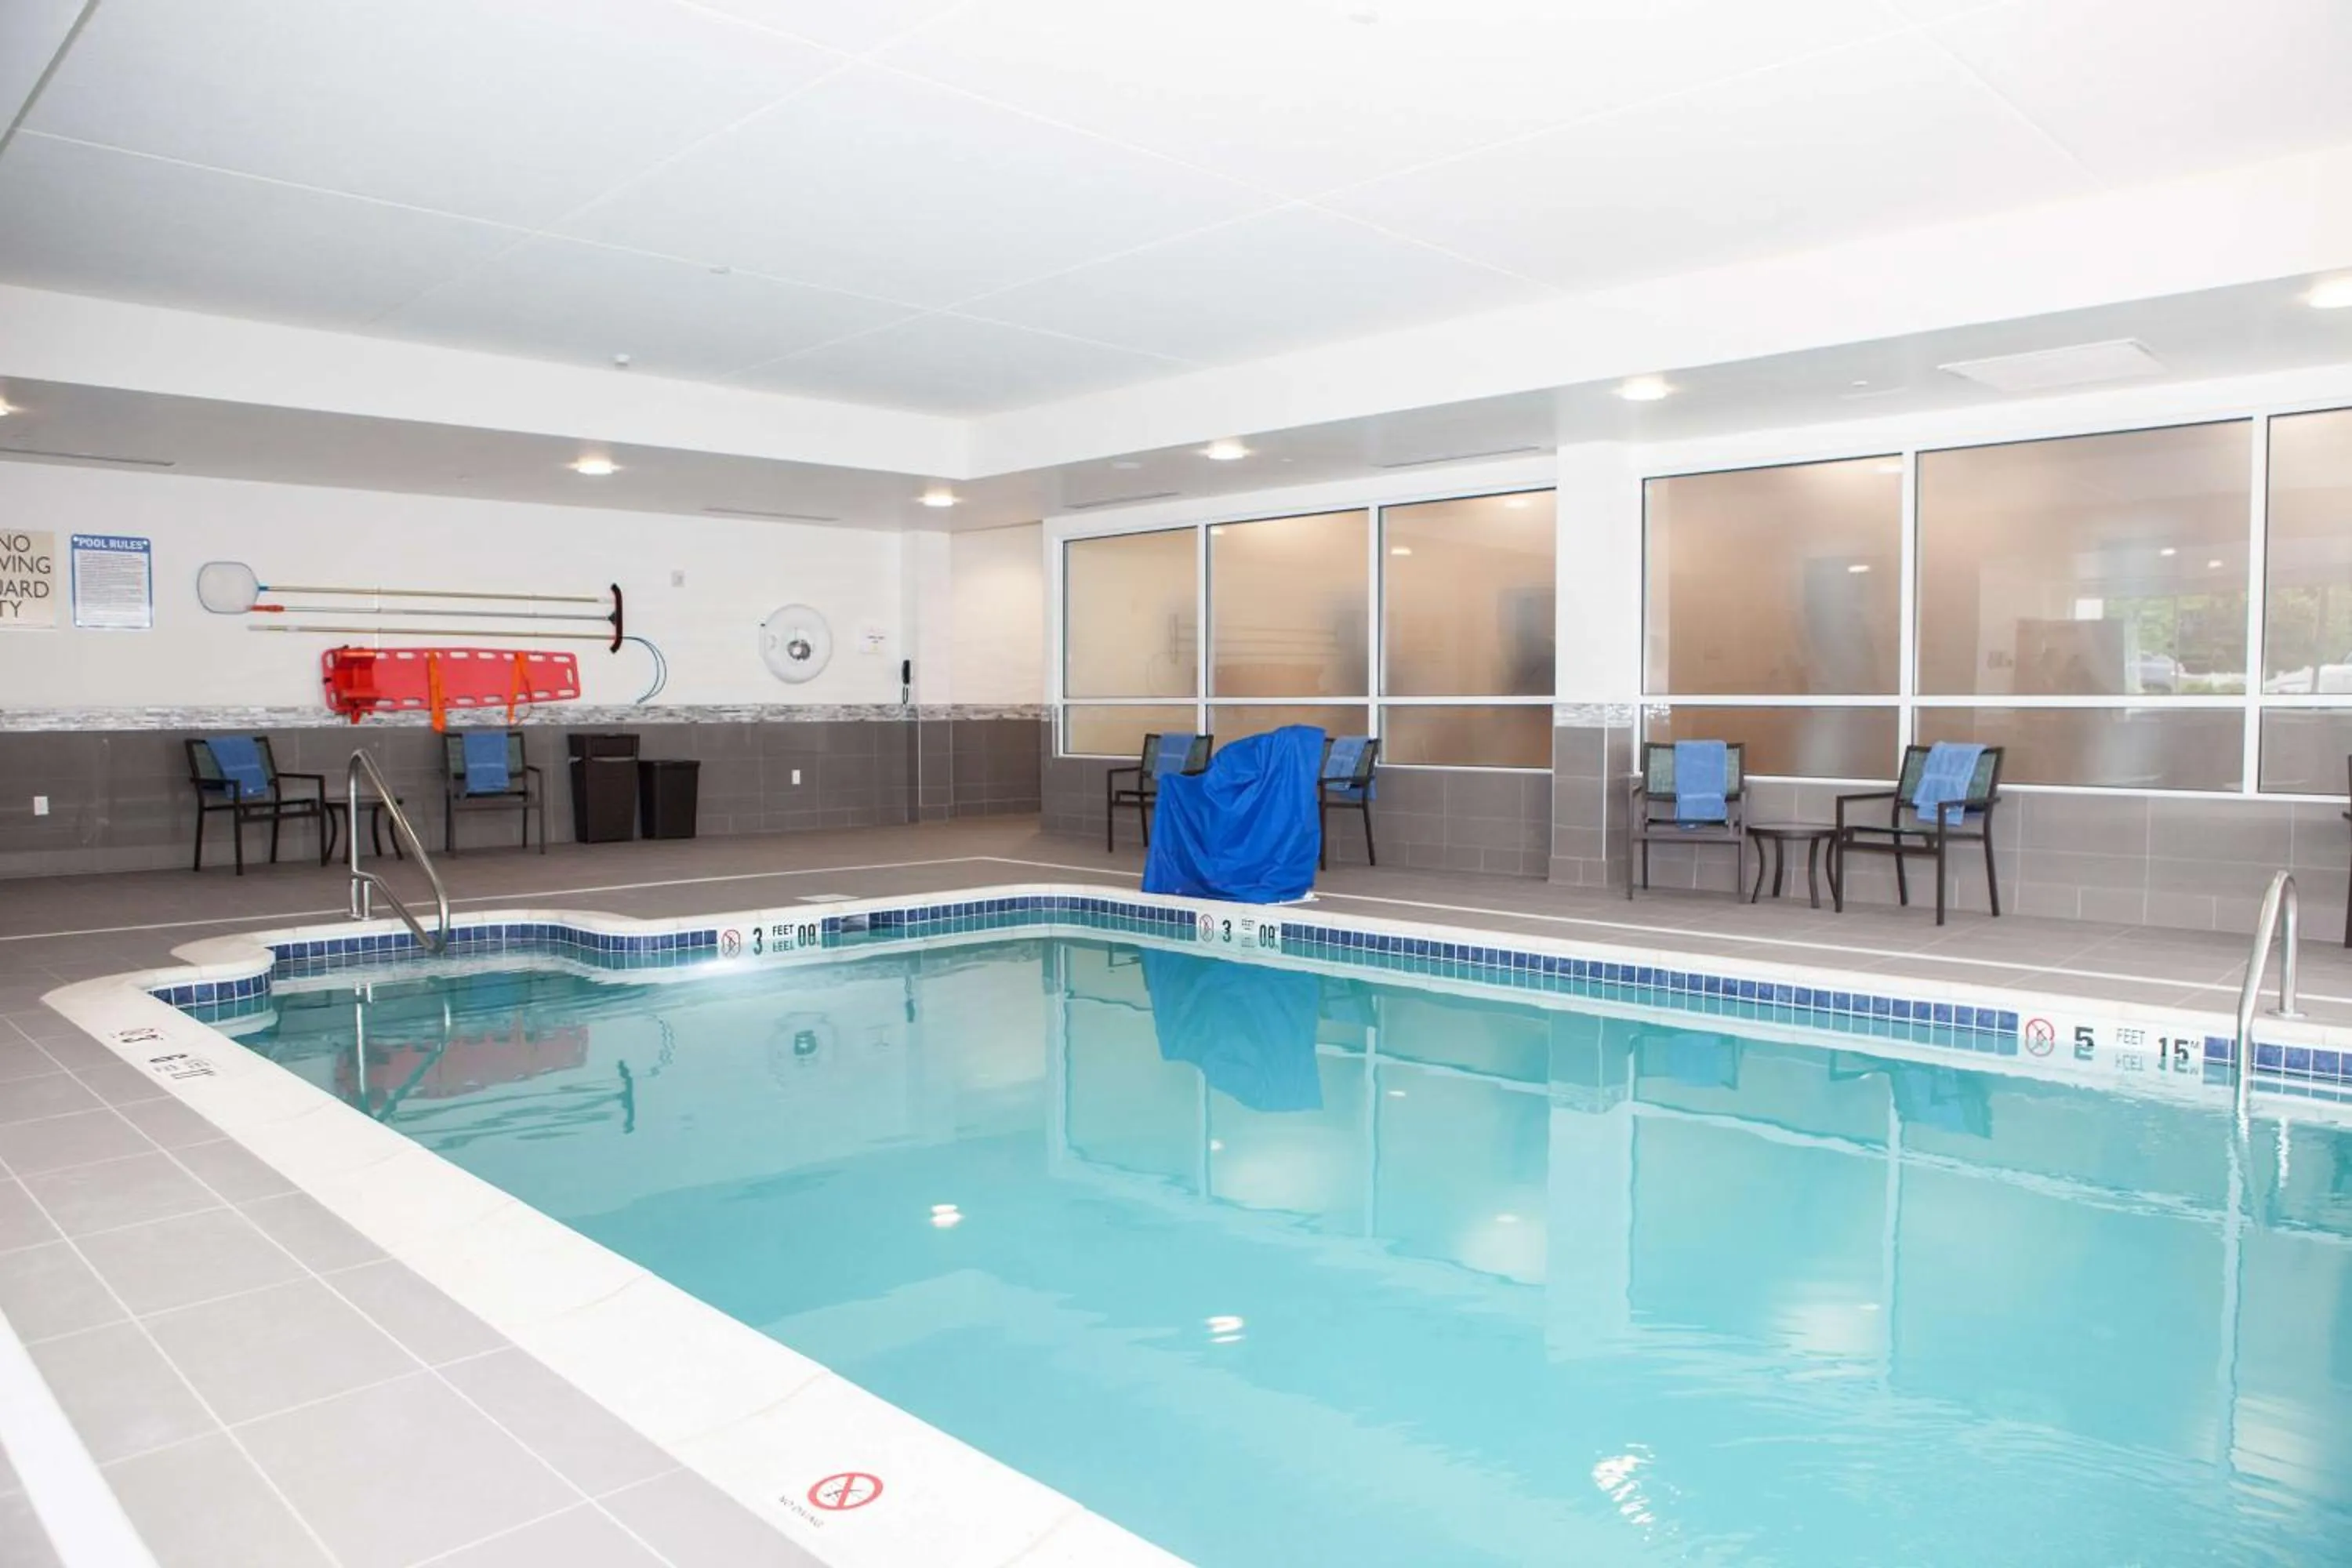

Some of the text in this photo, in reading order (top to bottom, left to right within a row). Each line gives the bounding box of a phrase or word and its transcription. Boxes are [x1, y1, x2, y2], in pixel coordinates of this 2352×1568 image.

[0, 534, 31, 553] NO
[79, 537, 143, 550] POOL RULES
[0, 579, 49, 598] ARD
[772, 924, 794, 936] FEET
[2117, 1028, 2145, 1045] FEET
